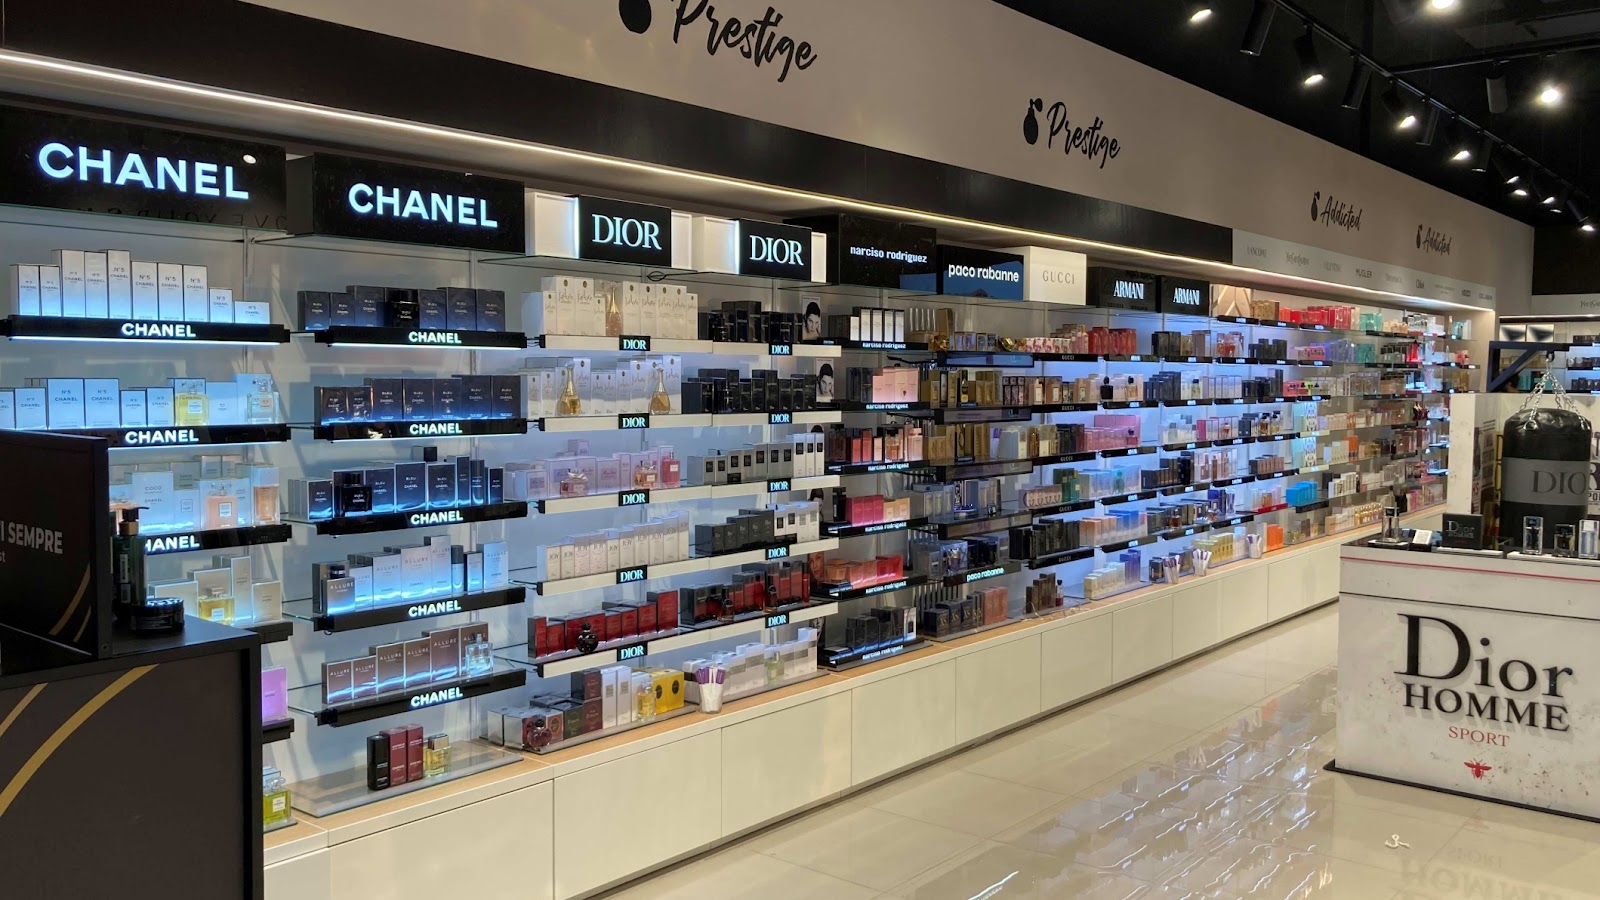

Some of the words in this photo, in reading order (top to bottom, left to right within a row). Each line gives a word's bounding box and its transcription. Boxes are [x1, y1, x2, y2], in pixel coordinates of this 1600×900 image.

[671, 0, 817, 82] Prestige
[1047, 101, 1120, 169] Prestige
[38, 142, 249, 200] CHANEL
[348, 183, 498, 228] CHANEL
[1320, 195, 1362, 231] Addicted
[591, 214, 662, 250] DIOR
[1422, 227, 1452, 255] Addicted
[750, 235, 804, 266] DIOR
[850, 245, 884, 259] narciso
[886, 251, 927, 263] rodriguez
[948, 264, 975, 278] paco
[977, 267, 1019, 283] rabanne
[1042, 269, 1075, 284] GUCCI
[1114, 280, 1144, 300] ARMANI
[1173, 287, 1200, 306] ARMANI
[121, 322, 197, 338] CHANEL
[408, 331, 462, 344] CHANEL
[623, 339, 647, 350] DIOR
[771, 345, 790, 354] DIOR
[622, 417, 646, 428] DIOR
[771, 413, 790, 423] DIOR
[125, 429, 199, 444] CHANEL
[409, 423, 463, 435] CHANEL
[770, 481, 788, 491] DIOR
[1532, 470, 1587, 495] DIO
[622, 493, 646, 505] DIOR
[411, 510, 463, 525] CHANEL
[1446, 520, 1475, 533] Dior
[8, 523, 63, 555] SEMPRE
[145, 535, 200, 552] HANEL
[768, 547, 787, 558] DIOR
[620, 569, 644, 582] DIOR
[966, 573, 981, 582] paco
[981, 567, 1004, 578] rabanne
[330, 581, 354, 590] ALLURE
[408, 599, 462, 618] CHANEL
[768, 614, 787, 626] DIOR
[434, 638, 457, 647] ALLURE
[379, 652, 402, 661] ALLURE
[407, 647, 429, 655] ALLURE
[620, 645, 644, 660] DIOR
[1393, 613, 1573, 698] Dior
[411, 687, 463, 707] CHANEL
[1403, 682, 1570, 732] HOMME
[1448, 726, 1510, 747] SPORT
